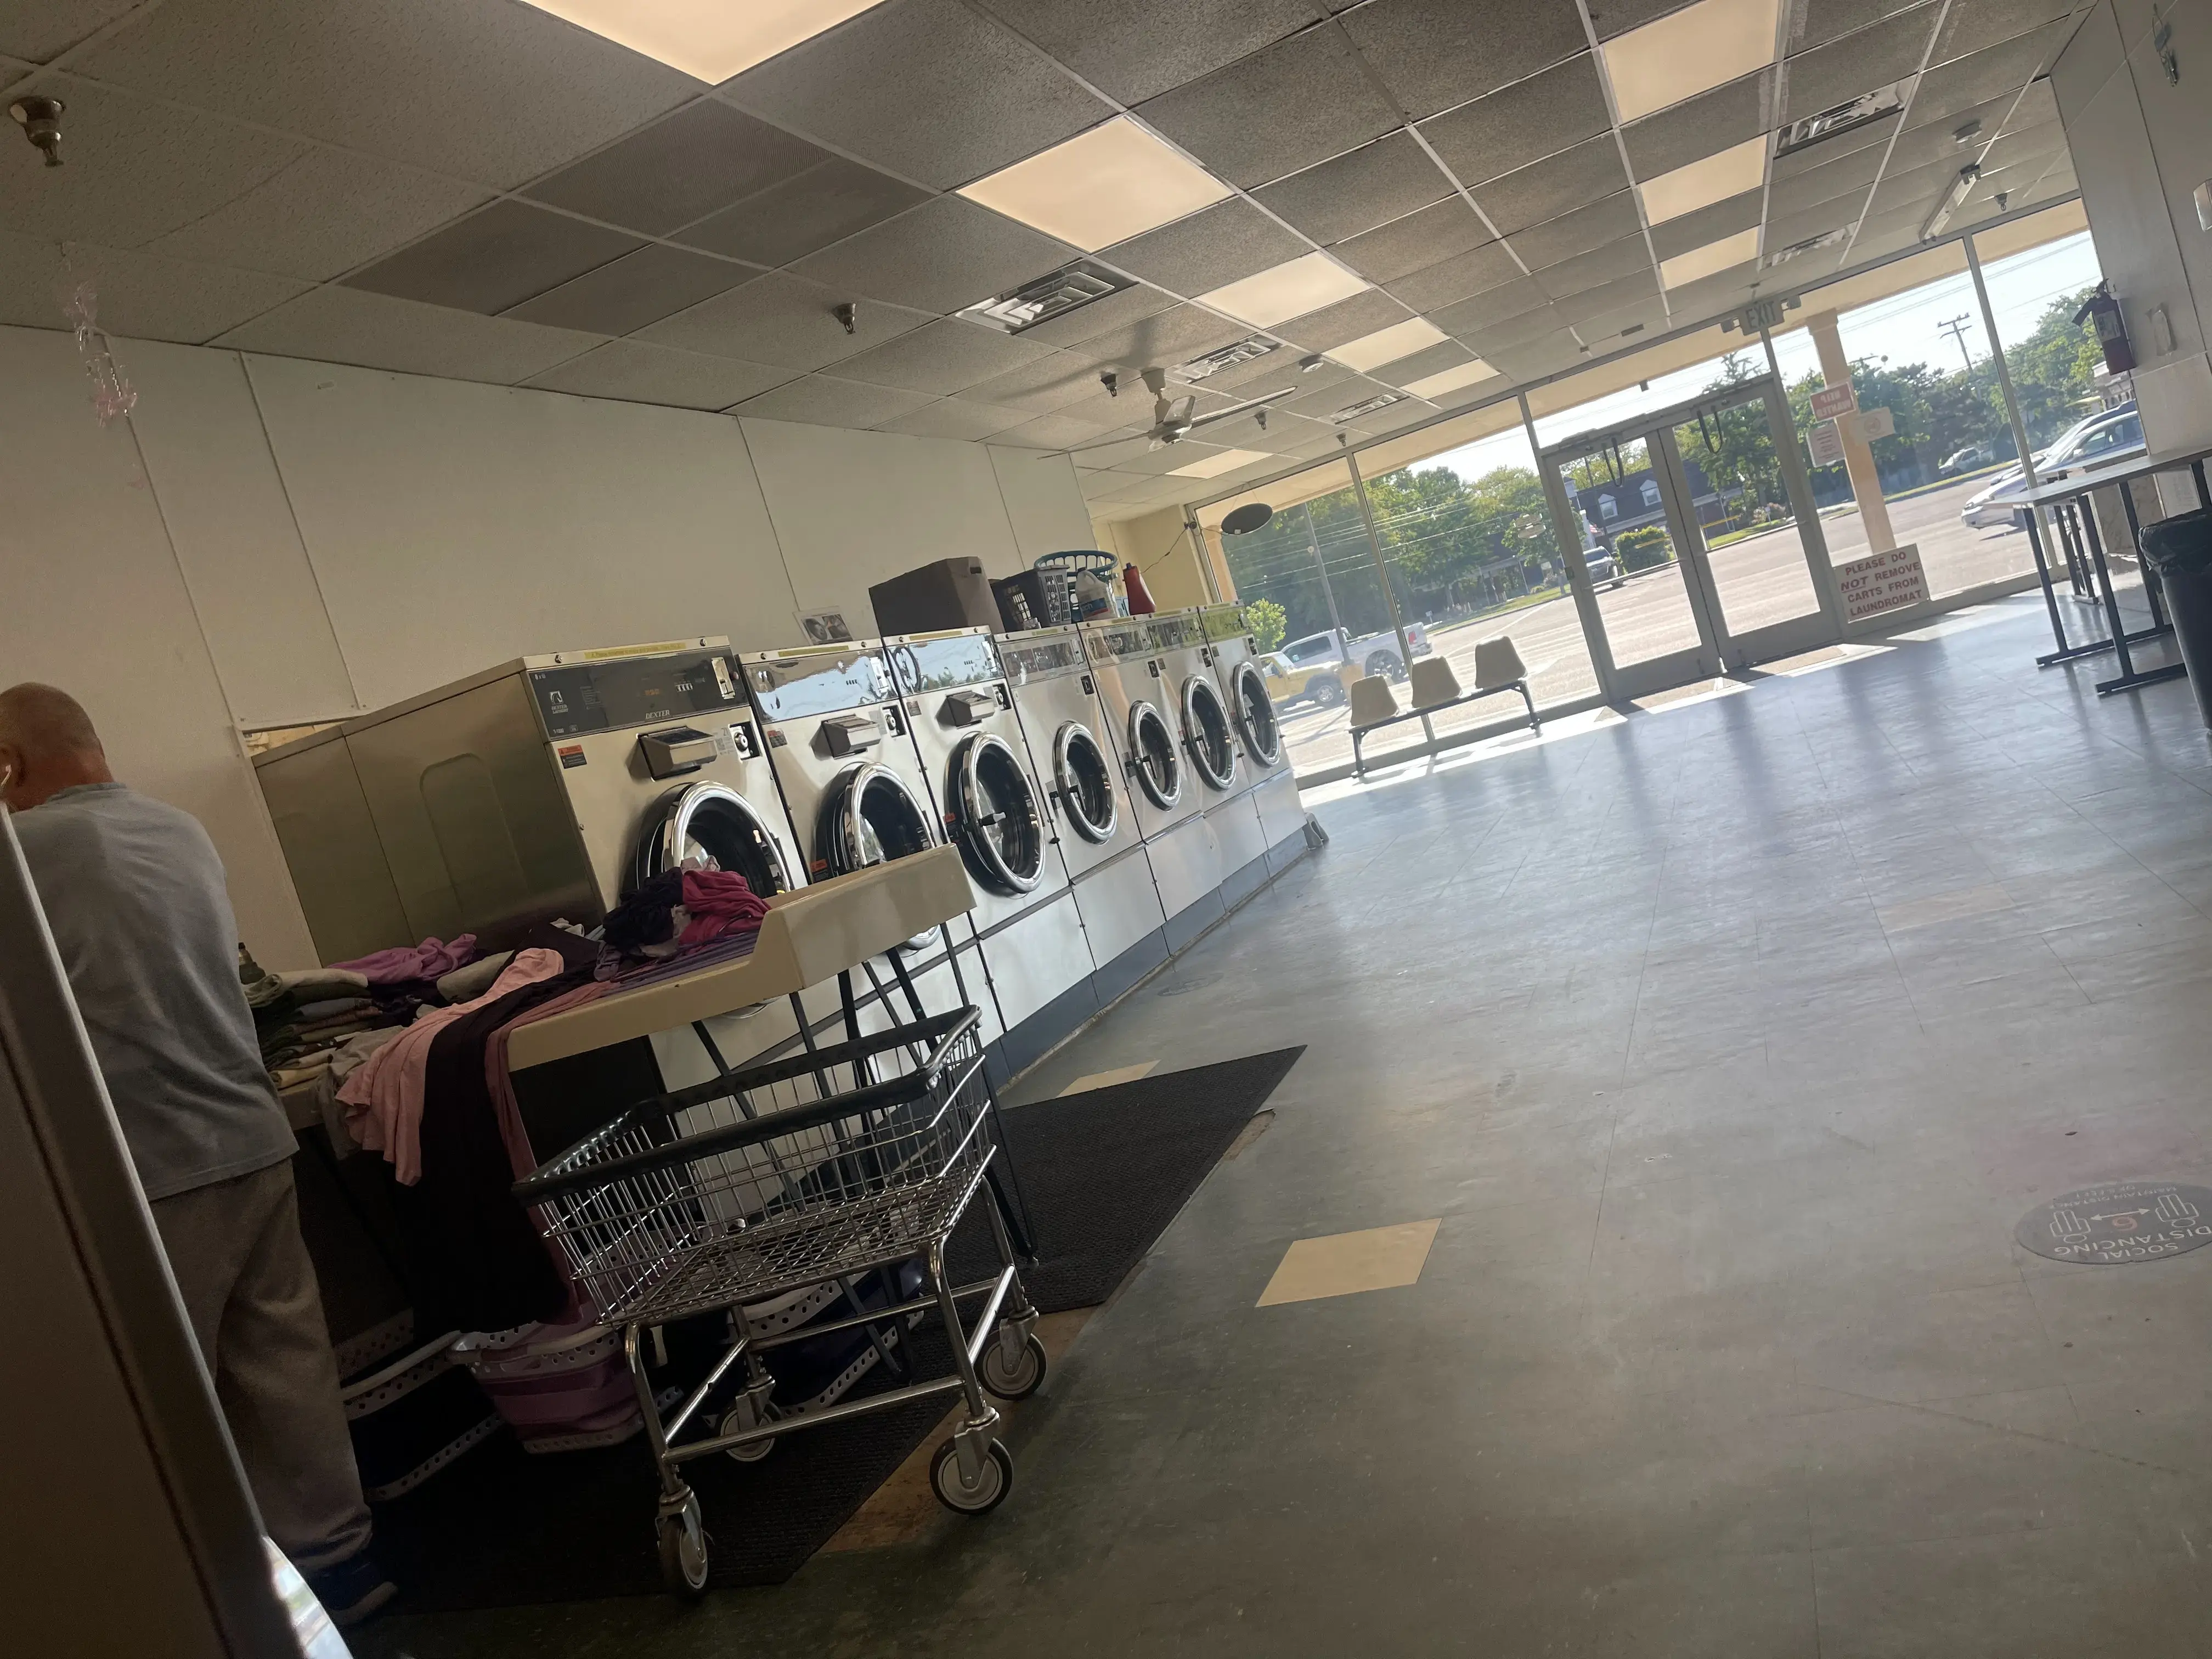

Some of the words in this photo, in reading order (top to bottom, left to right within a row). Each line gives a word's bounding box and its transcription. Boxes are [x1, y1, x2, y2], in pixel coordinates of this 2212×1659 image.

[1745, 301, 1776, 329] EXIT
[1841, 575, 1869, 592] NOT
[1875, 561, 1921, 582] REMOVE
[1845, 557, 1886, 575] PLEASE
[1891, 551, 1906, 563] DO
[1847, 586, 1883, 603] CARTS
[1888, 576, 1920, 592] FROM
[1849, 589, 1922, 617] LAUNDROMAT
[645, 709, 670, 719] DEXTER
[2112, 1216, 2138, 1231] 6
[2054, 1225, 2212, 1255] DISTANCING
[2097, 1242, 2179, 1260] SOCIAL
